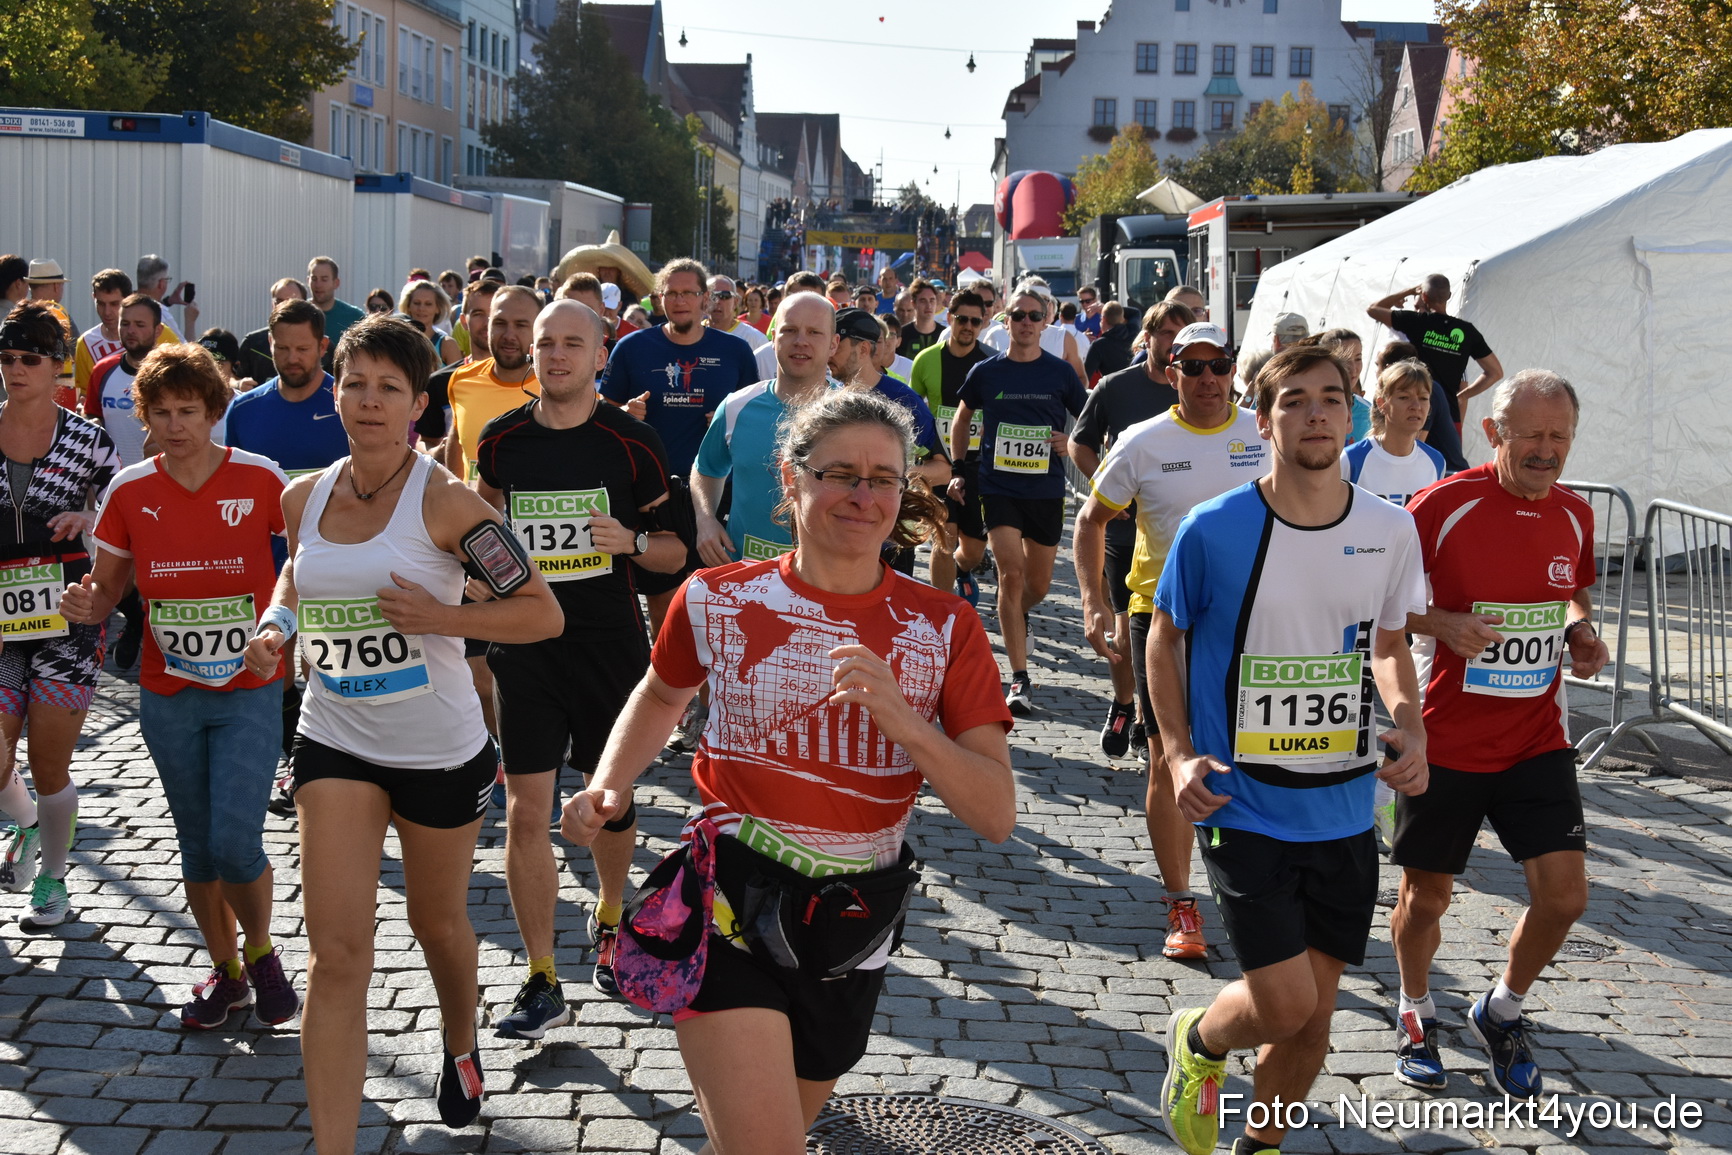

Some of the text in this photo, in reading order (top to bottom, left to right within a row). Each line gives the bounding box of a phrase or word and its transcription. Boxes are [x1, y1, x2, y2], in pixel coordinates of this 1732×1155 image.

[5, 117, 21, 125] DIXI
[54, 119, 66, 127] 536
[842, 235, 880, 245] START
[1422, 337, 1460, 351] neumarkt
[1424, 330, 1449, 342] physio
[1002, 425, 1047, 438] BOCK
[1003, 441, 1045, 457] 1184
[1229, 443, 1245, 453] 20
[1004, 460, 1040, 468] MARKUS
[1162, 462, 1191, 470] BOCK
[1230, 460, 1260, 468] Stadtlauf
[518, 494, 596, 514] BOCK
[522, 523, 596, 551] 1321
[160, 601, 243, 621] BOCK
[787, 604, 823, 620] 10.54
[0, 618, 52, 633] ELANIE
[163, 627, 246, 657] 2070
[311, 632, 409, 671] 2760
[1480, 635, 1555, 666] 3001
[179, 660, 237, 677] MARION
[781, 658, 819, 675] 52.01
[1252, 661, 1350, 682] BOCK
[340, 677, 388, 694] ALEX
[780, 677, 818, 696] 26.22
[1488, 672, 1547, 687] RUDOLF
[1255, 692, 1348, 727] 1136
[1269, 737, 1330, 752] LUKAS
